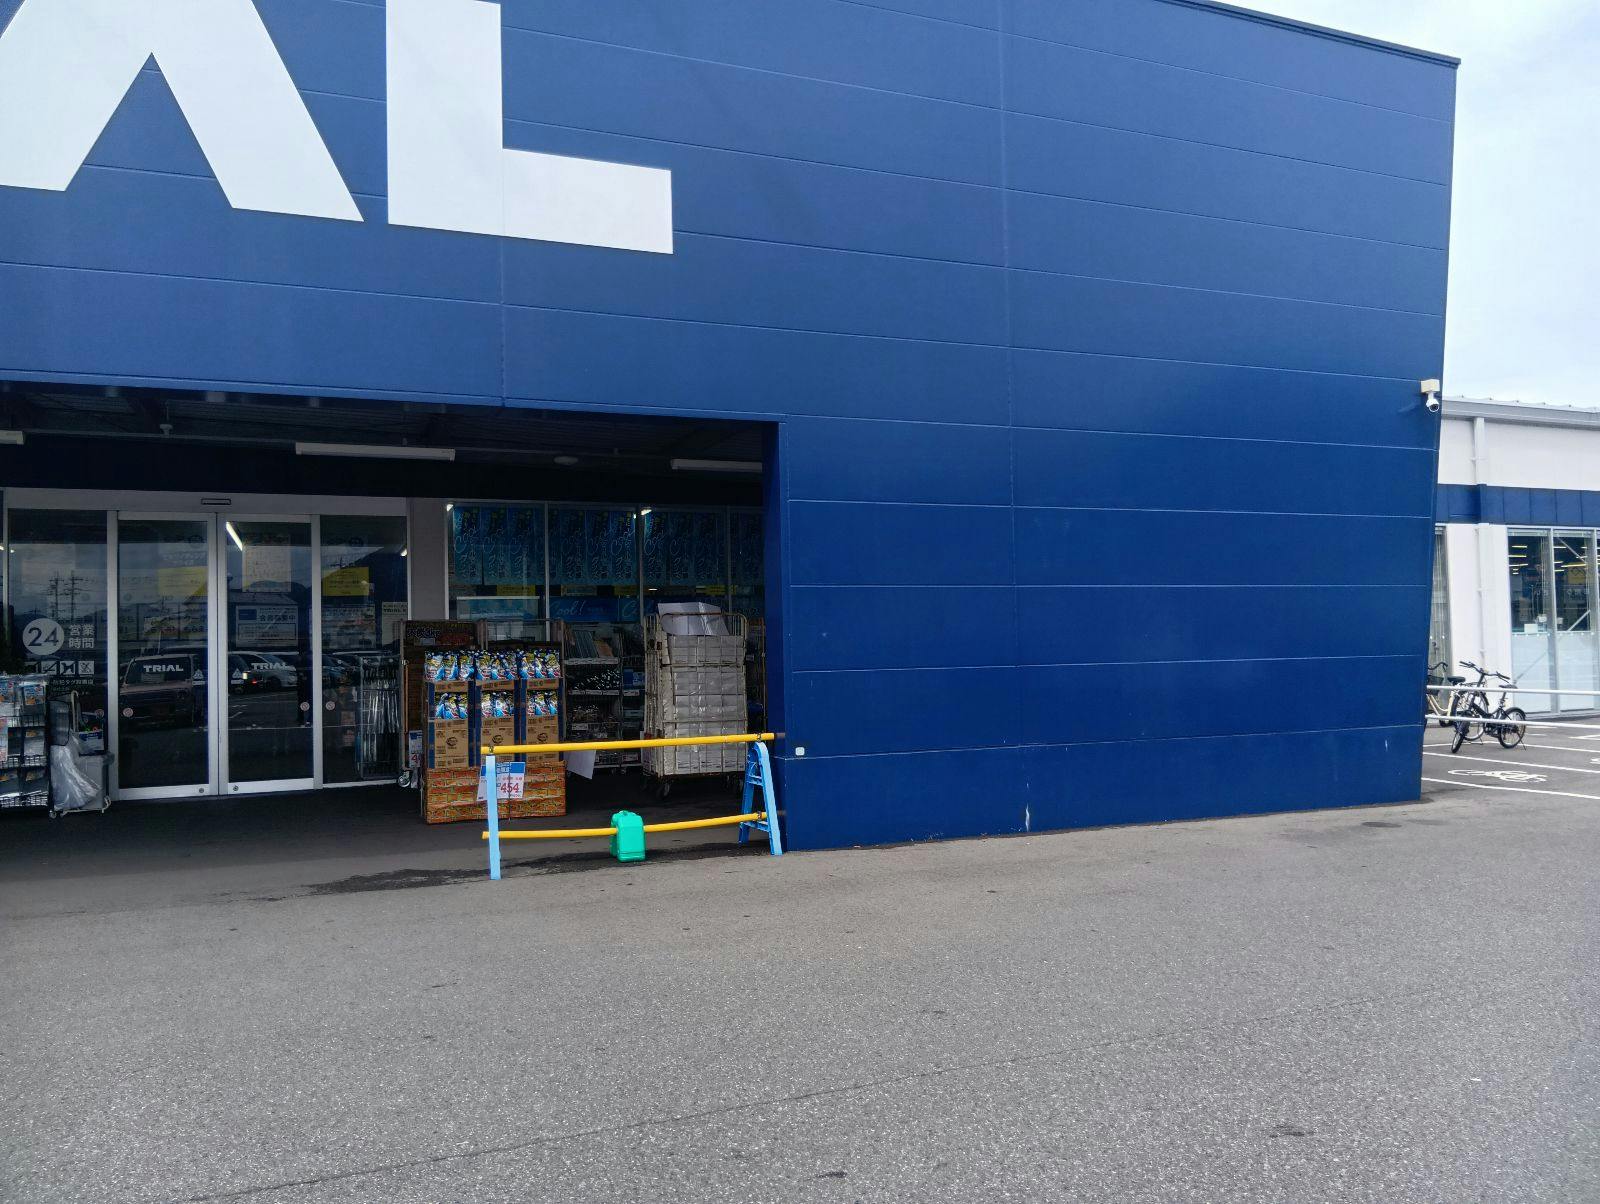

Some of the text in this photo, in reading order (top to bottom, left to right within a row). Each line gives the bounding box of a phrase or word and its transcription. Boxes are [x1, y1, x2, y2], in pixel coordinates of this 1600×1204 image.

[69, 624, 95, 636] 営業
[28, 627, 59, 647] 24
[68, 637, 95, 649] 時間
[143, 664, 184, 673] TRIAL
[500, 782, 519, 793] 454
